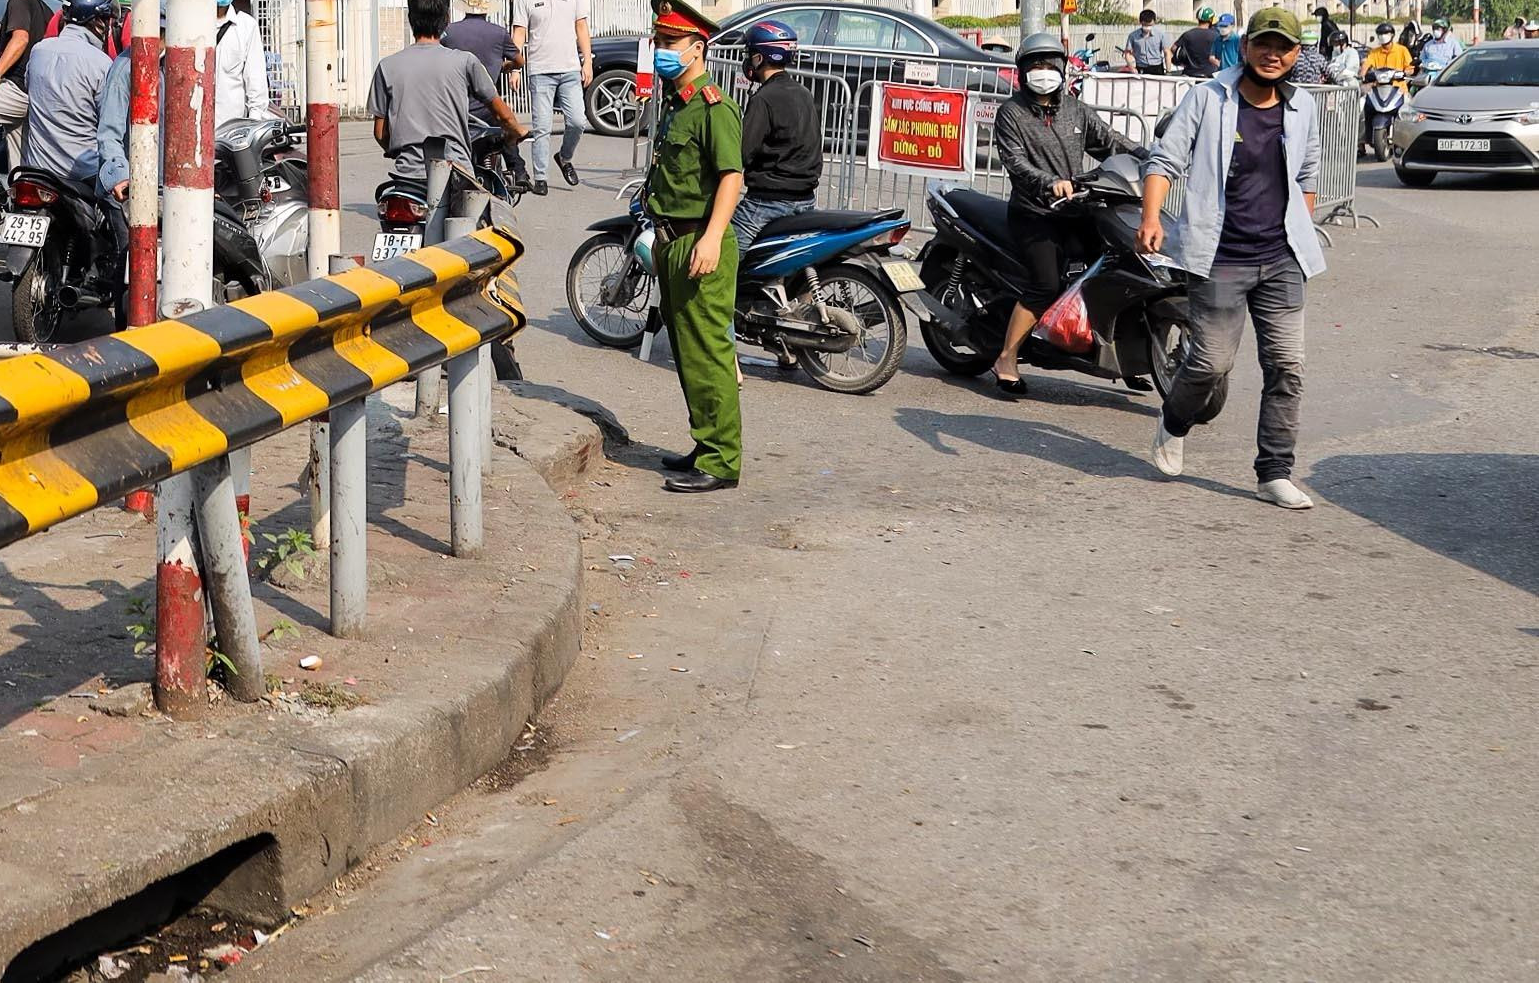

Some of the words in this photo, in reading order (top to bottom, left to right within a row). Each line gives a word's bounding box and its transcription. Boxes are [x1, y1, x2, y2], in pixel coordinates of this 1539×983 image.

[933, 100, 951, 116] VIỆN
[911, 120, 939, 137] PHƯƠNG
[940, 123, 959, 142] TIỆN
[10, 217, 42, 230] 29-Y5
[4, 230, 43, 244] 442.95
[384, 235, 414, 246] 18-F1
